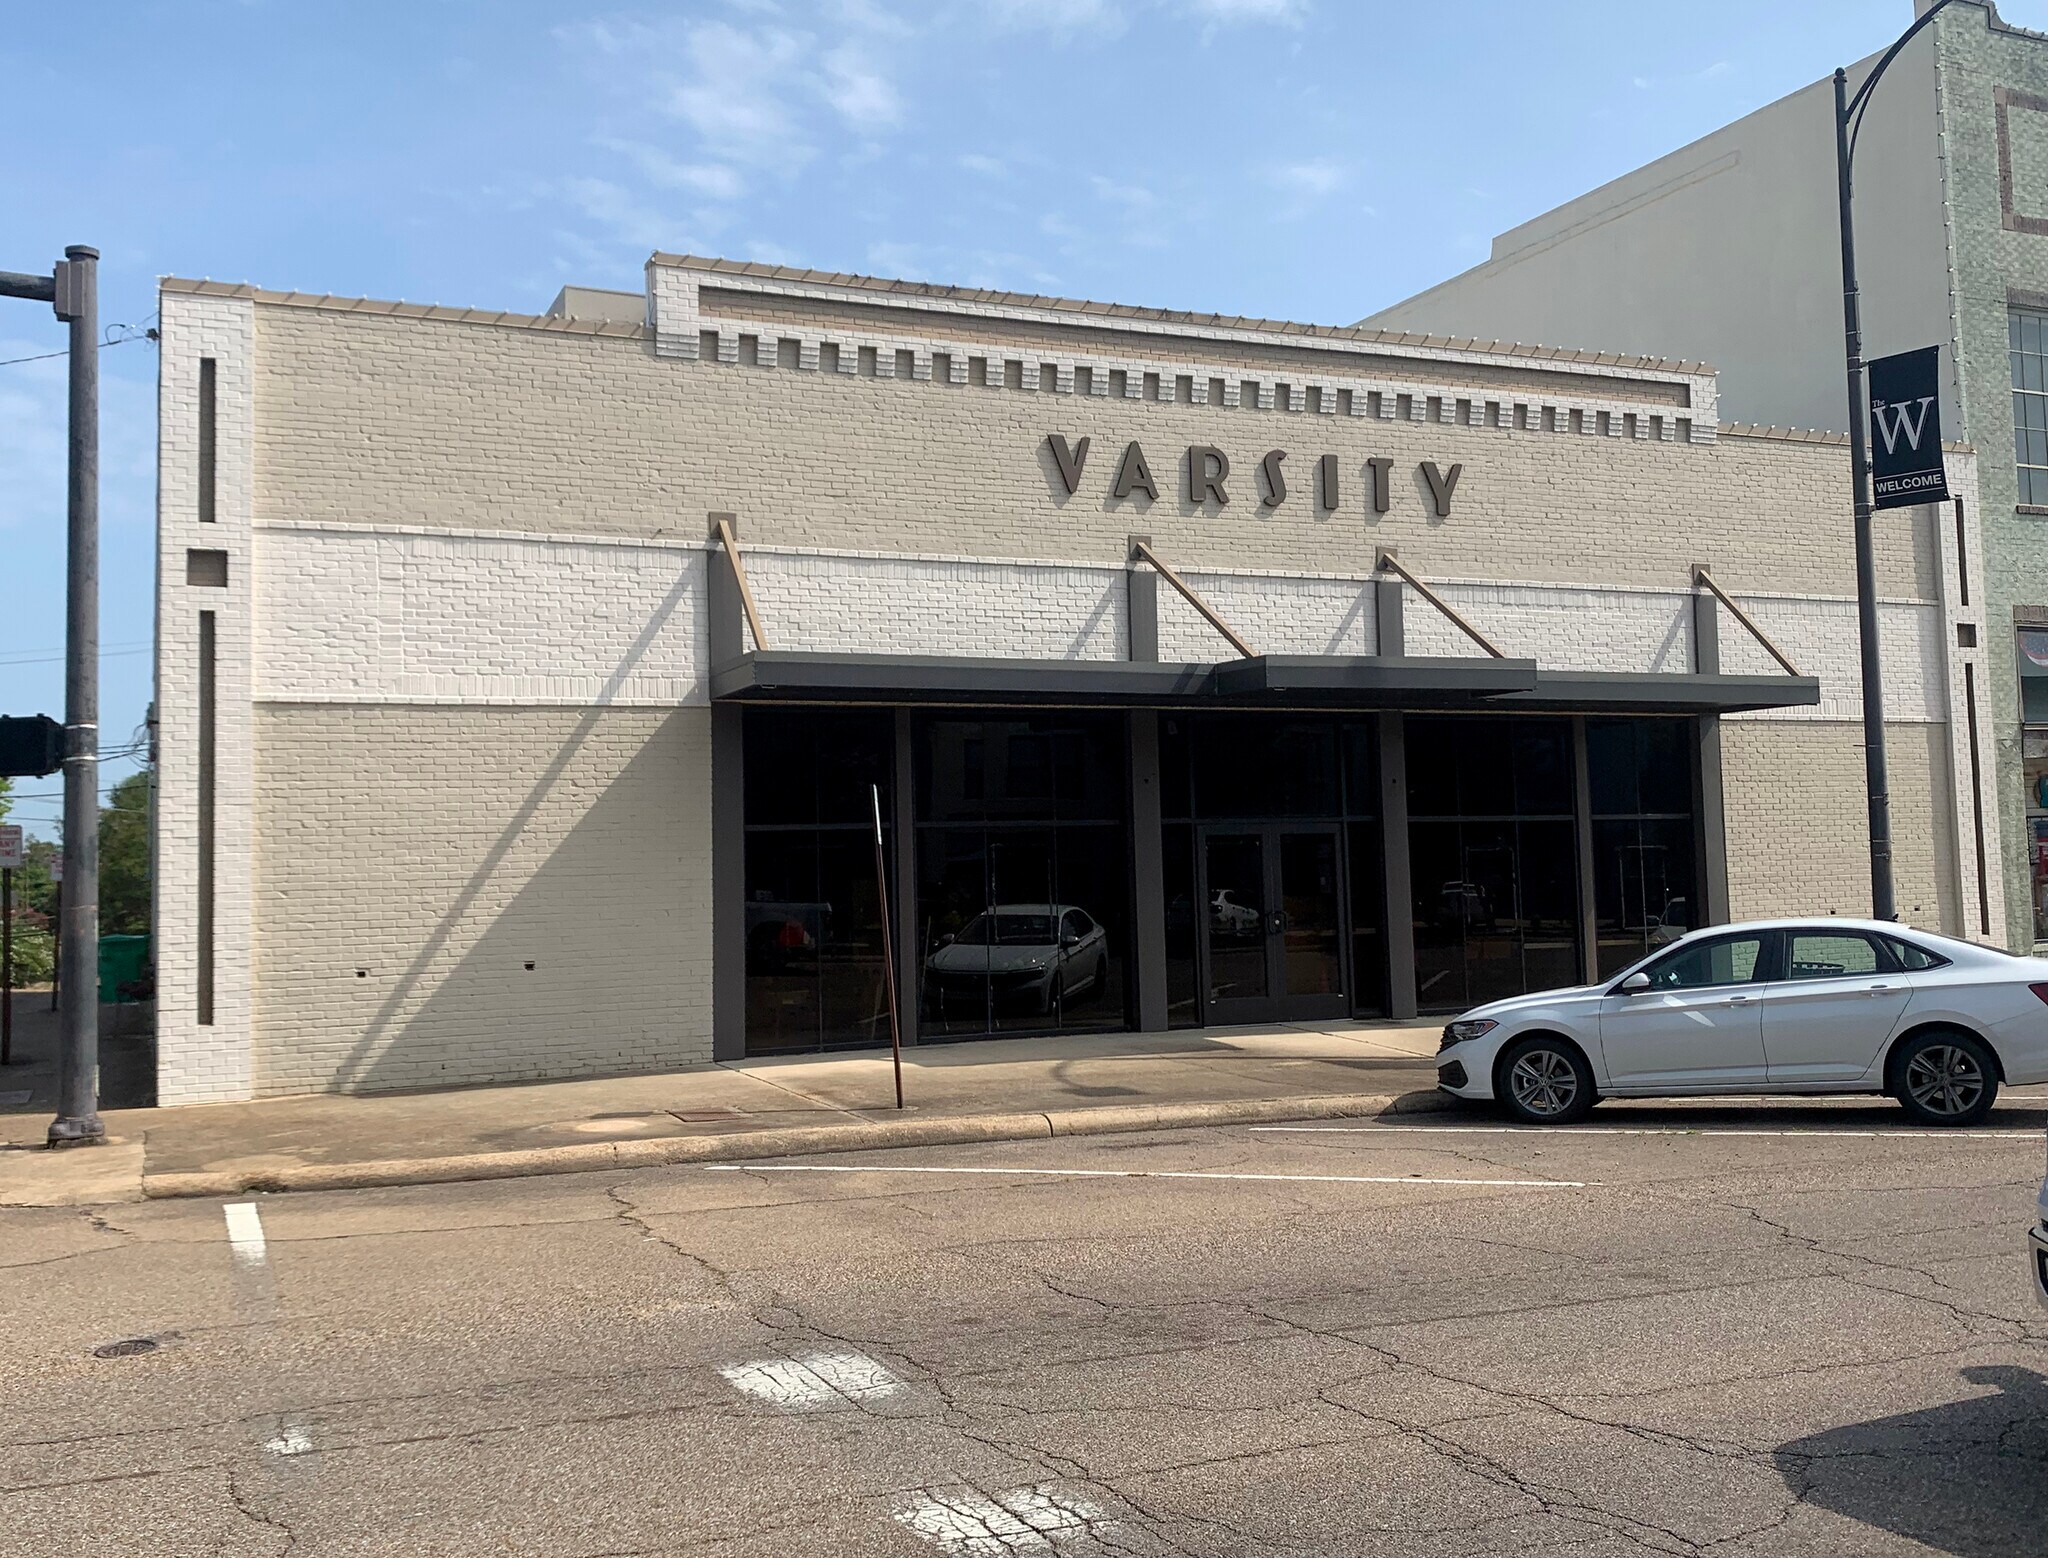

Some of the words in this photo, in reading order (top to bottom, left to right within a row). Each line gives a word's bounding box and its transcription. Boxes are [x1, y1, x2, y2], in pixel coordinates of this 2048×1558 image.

[1872, 399, 1886, 408] The
[1872, 396, 1936, 455] W
[1047, 434, 1462, 516] VARSITY
[1876, 473, 1942, 493] WELCOME
